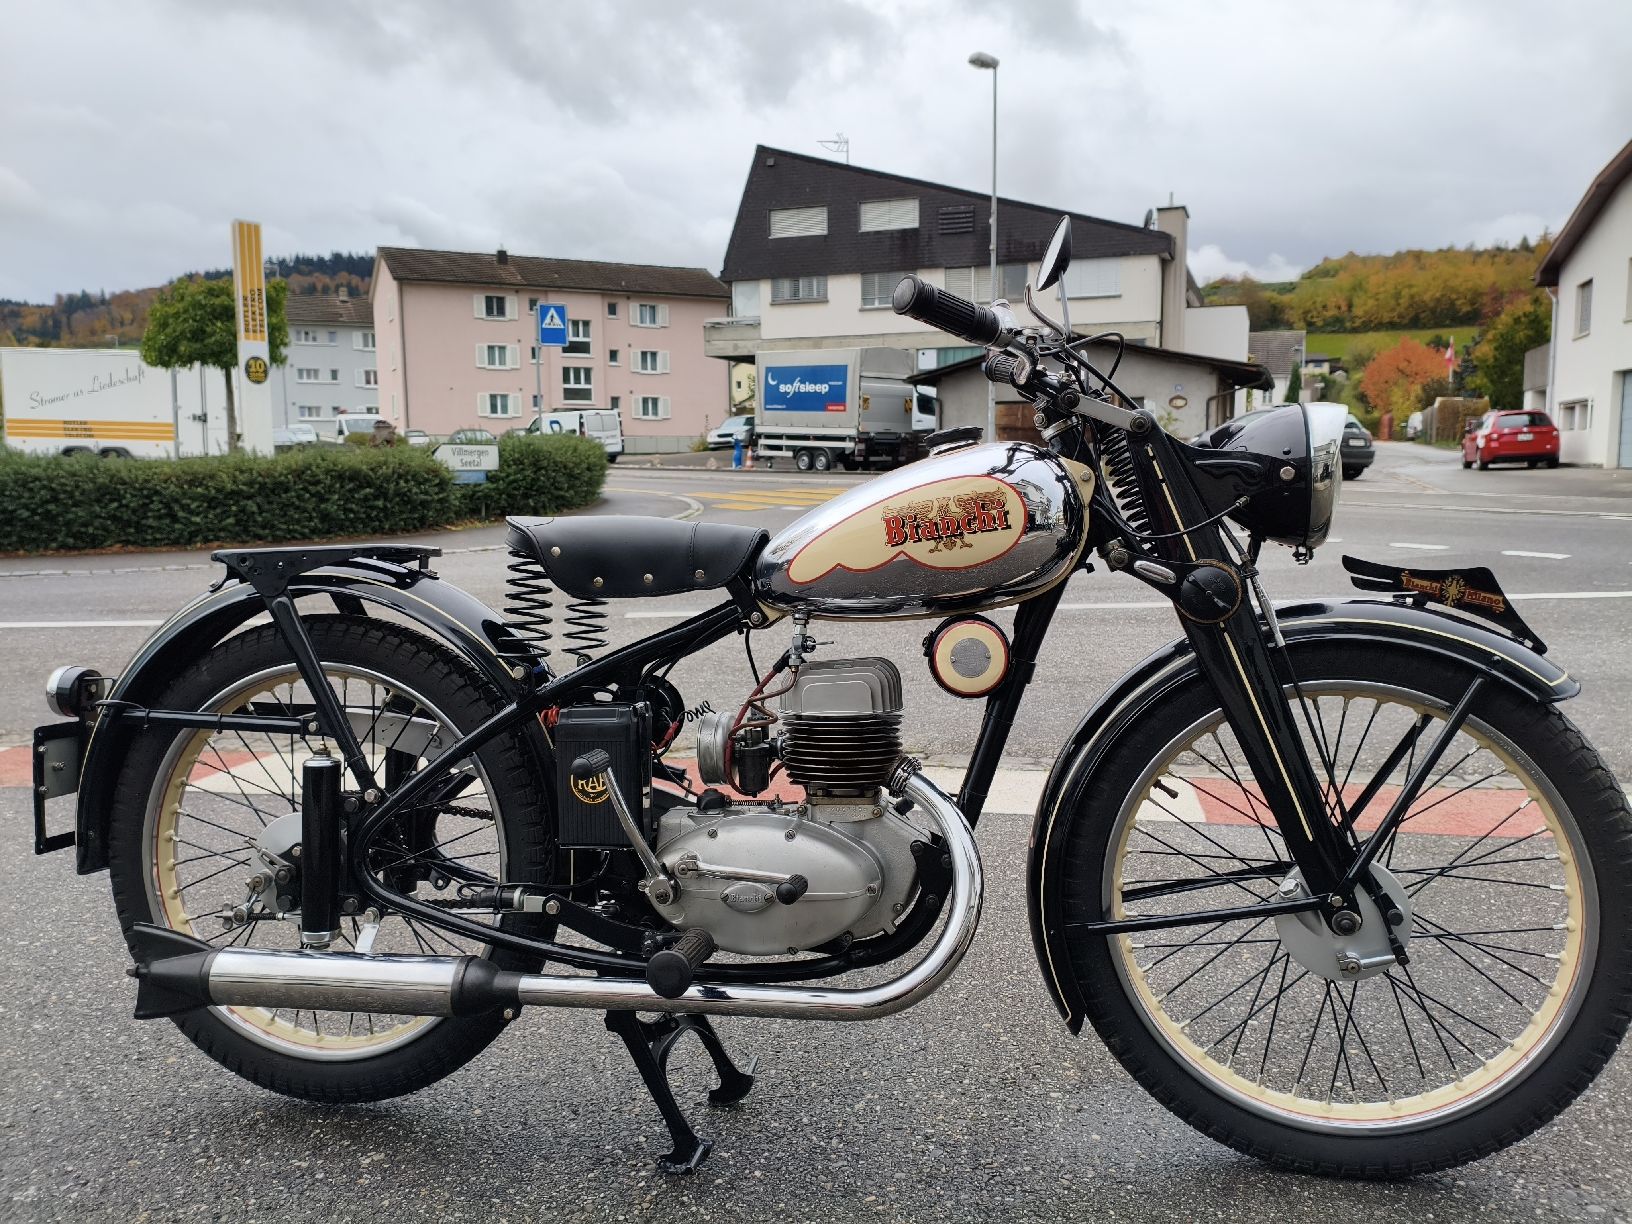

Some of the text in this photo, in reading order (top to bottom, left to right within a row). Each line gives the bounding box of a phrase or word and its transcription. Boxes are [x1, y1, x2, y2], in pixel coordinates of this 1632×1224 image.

[779, 377, 829, 398] softsleep
[460, 459, 482, 468] Seetal
[883, 499, 1011, 547] Bianchi
[1404, 577, 1500, 605] Bianchi Milano
[730, 893, 762, 903] Bianchi
